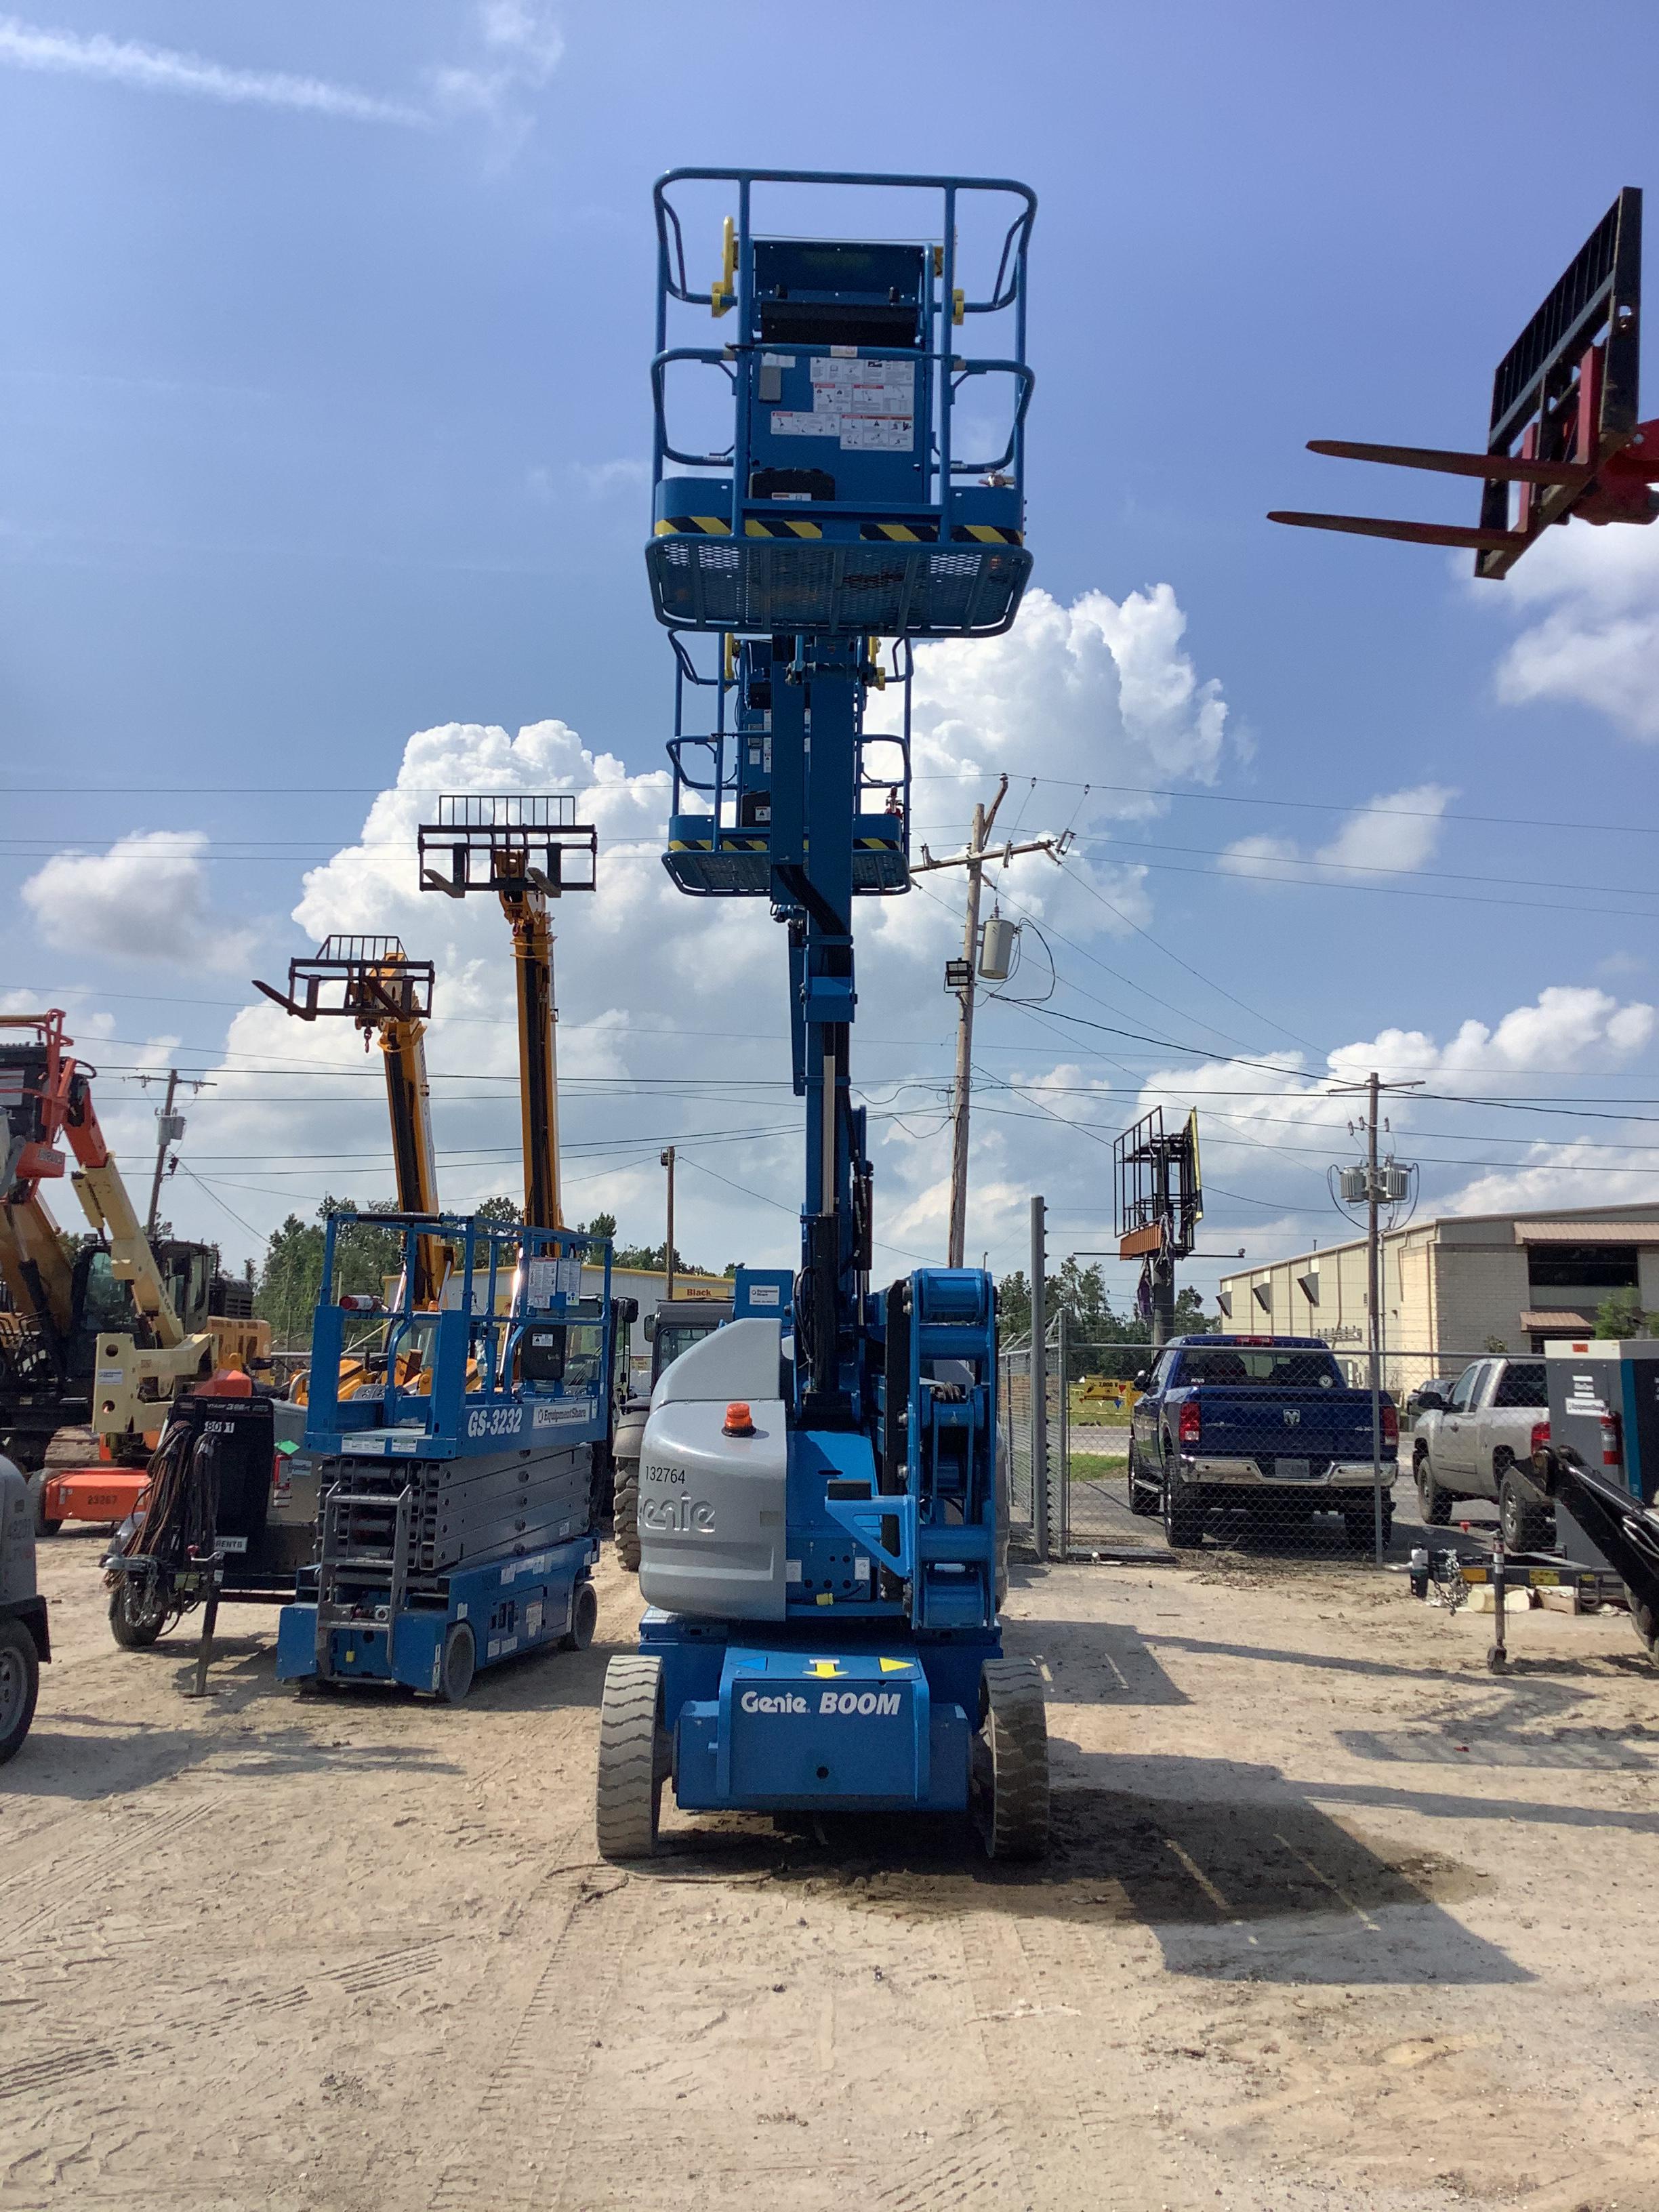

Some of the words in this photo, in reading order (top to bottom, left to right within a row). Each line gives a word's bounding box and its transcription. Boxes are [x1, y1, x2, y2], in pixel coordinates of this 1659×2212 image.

[687, 1288, 712, 1296] Black
[468, 1408, 523, 1437] GS-3232
[645, 1466, 686, 1484] 132764
[637, 1491, 716, 1533] enie
[741, 1691, 807, 1713] Genie
[819, 1692, 901, 1715] BOOM
